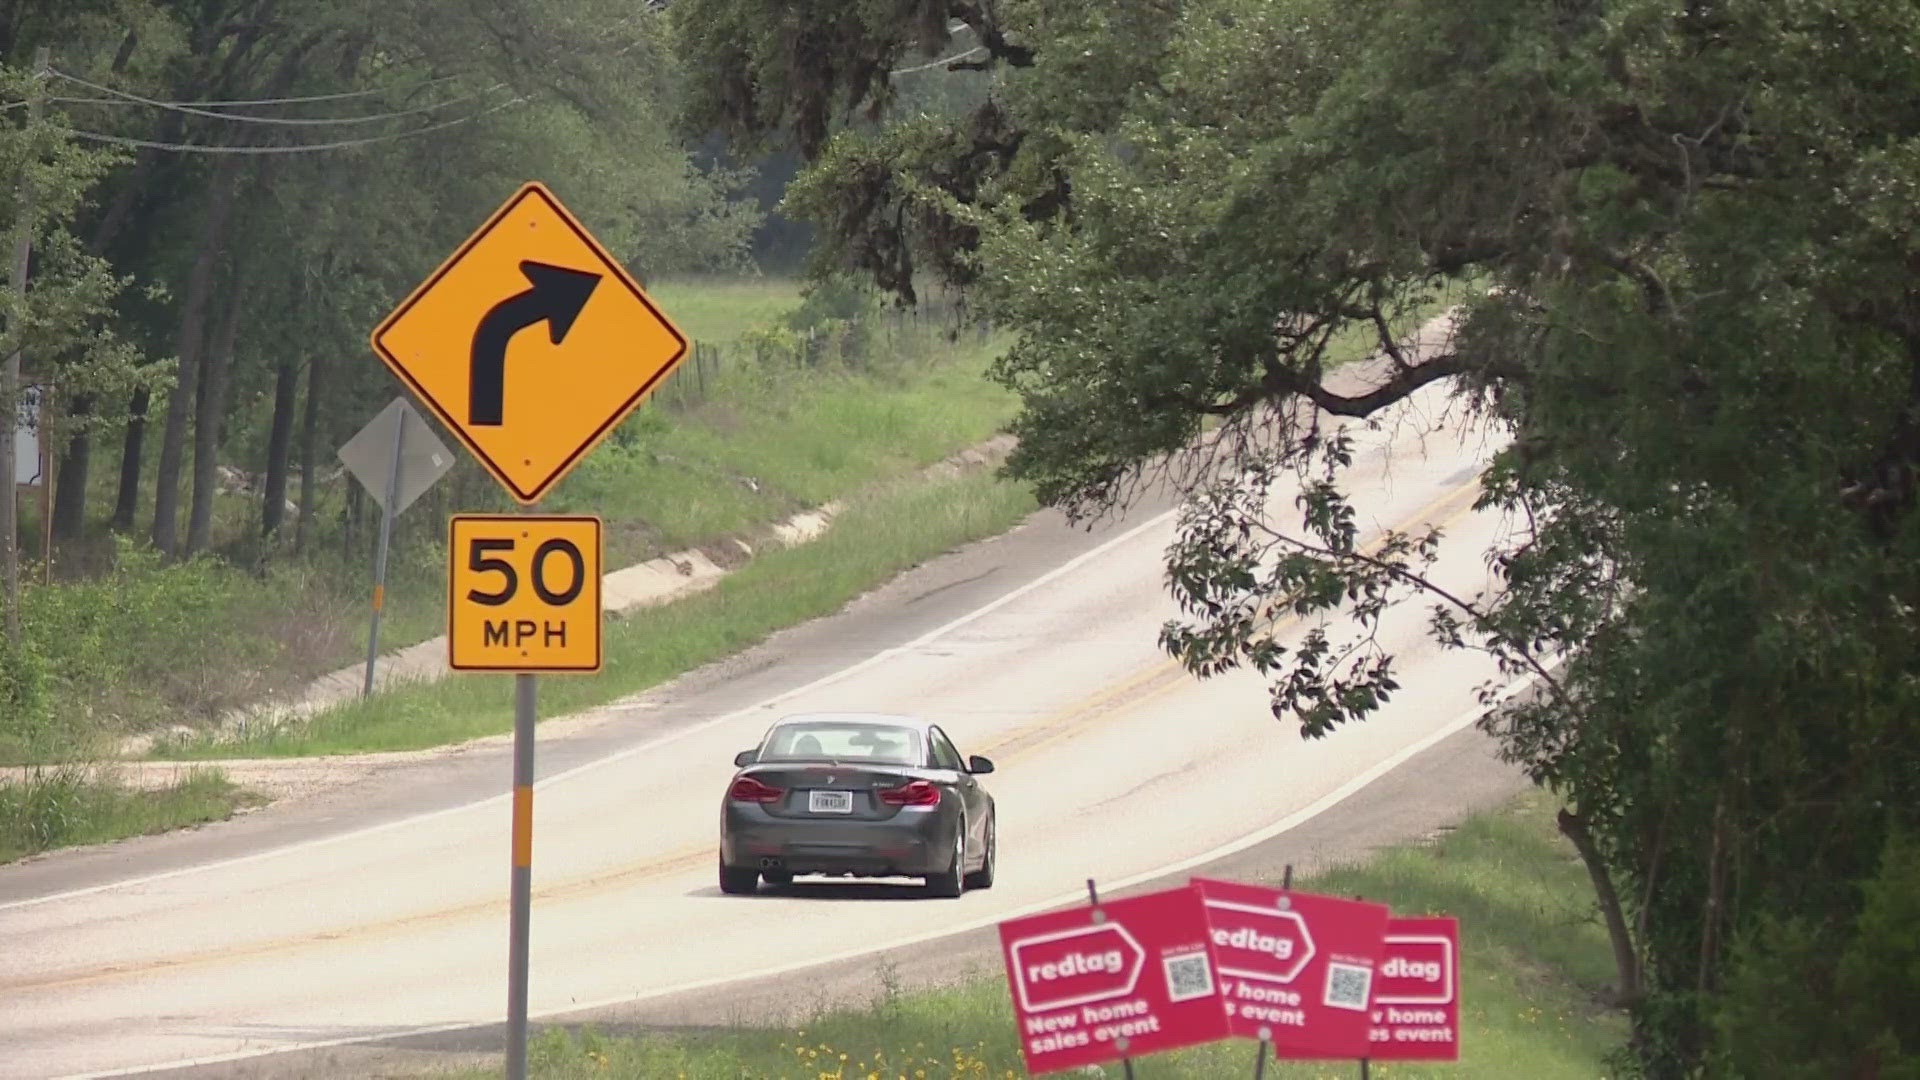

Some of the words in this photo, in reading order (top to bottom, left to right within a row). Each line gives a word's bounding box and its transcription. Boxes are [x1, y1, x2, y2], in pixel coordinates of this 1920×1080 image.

[467, 537, 585, 606] 50
[484, 619, 566, 648] MPH
[1209, 927, 1294, 960] edtag
[1028, 951, 1123, 983] redtag
[1381, 957, 1440, 982] dtag
[1237, 982, 1302, 1006] home
[1026, 1013, 1077, 1035] New
[1082, 1000, 1148, 1025] home
[1241, 1005, 1305, 1026] event
[1388, 1007, 1447, 1024] home
[1030, 1030, 1089, 1055] sales
[1094, 1016, 1160, 1041] event
[1395, 1027, 1453, 1042] event
